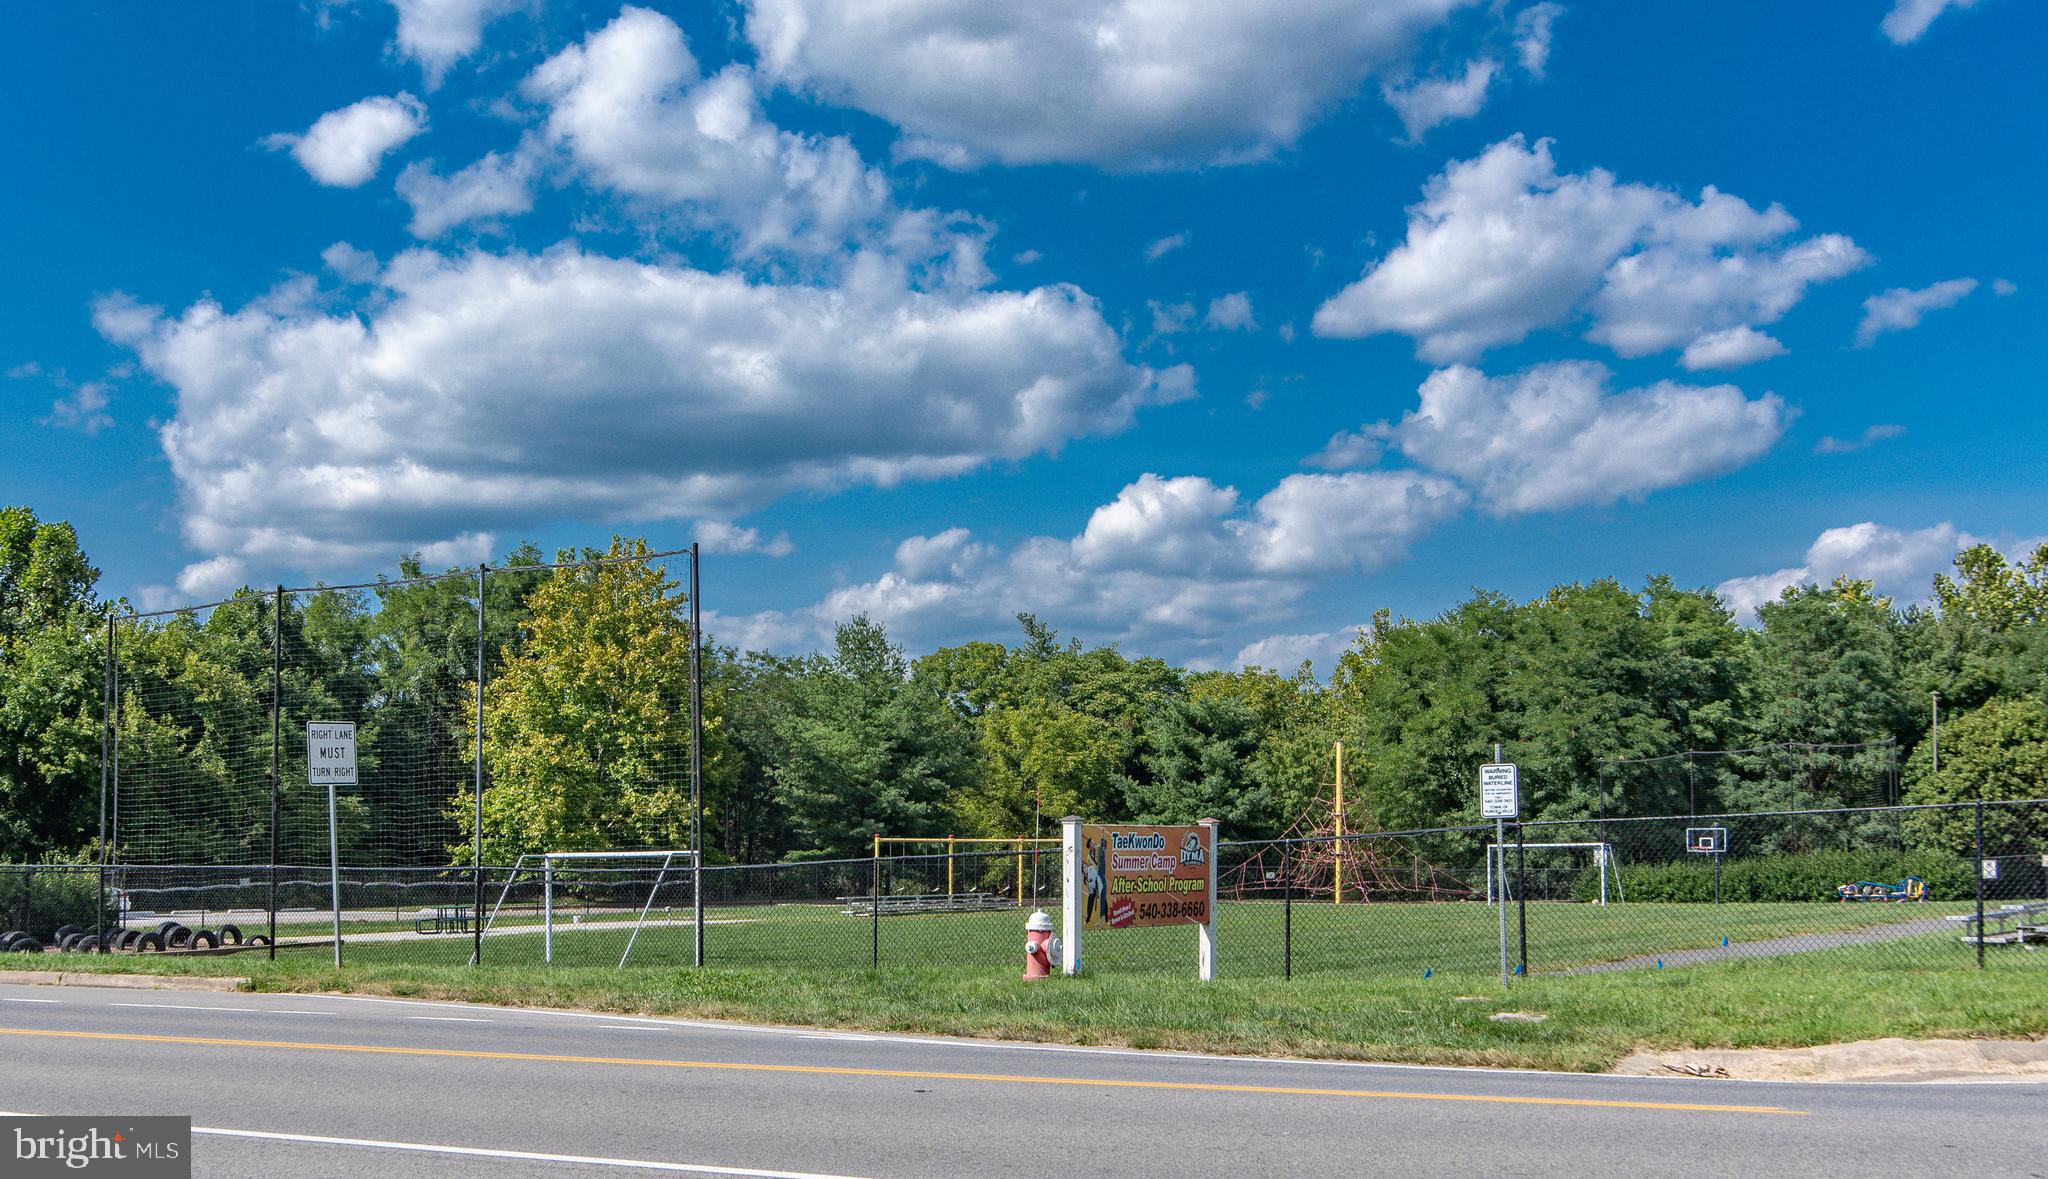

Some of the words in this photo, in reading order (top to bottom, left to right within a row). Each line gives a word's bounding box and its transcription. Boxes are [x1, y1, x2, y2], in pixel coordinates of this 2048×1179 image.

[311, 729, 332, 740] RIGHT
[334, 729, 353, 740] LANE
[320, 747, 345, 759] MUST
[312, 767, 331, 777] TURN
[334, 767, 354, 777] RIGHT
[1111, 832, 1165, 851] TaeKwonDo
[1111, 853, 1149, 870] Summer
[1151, 854, 1177, 873] Camp
[1180, 848, 1204, 863] DYMA
[1111, 876, 1168, 894] After-School
[1168, 876, 1204, 895] Program
[1139, 901, 1205, 919] 540-338-6660
